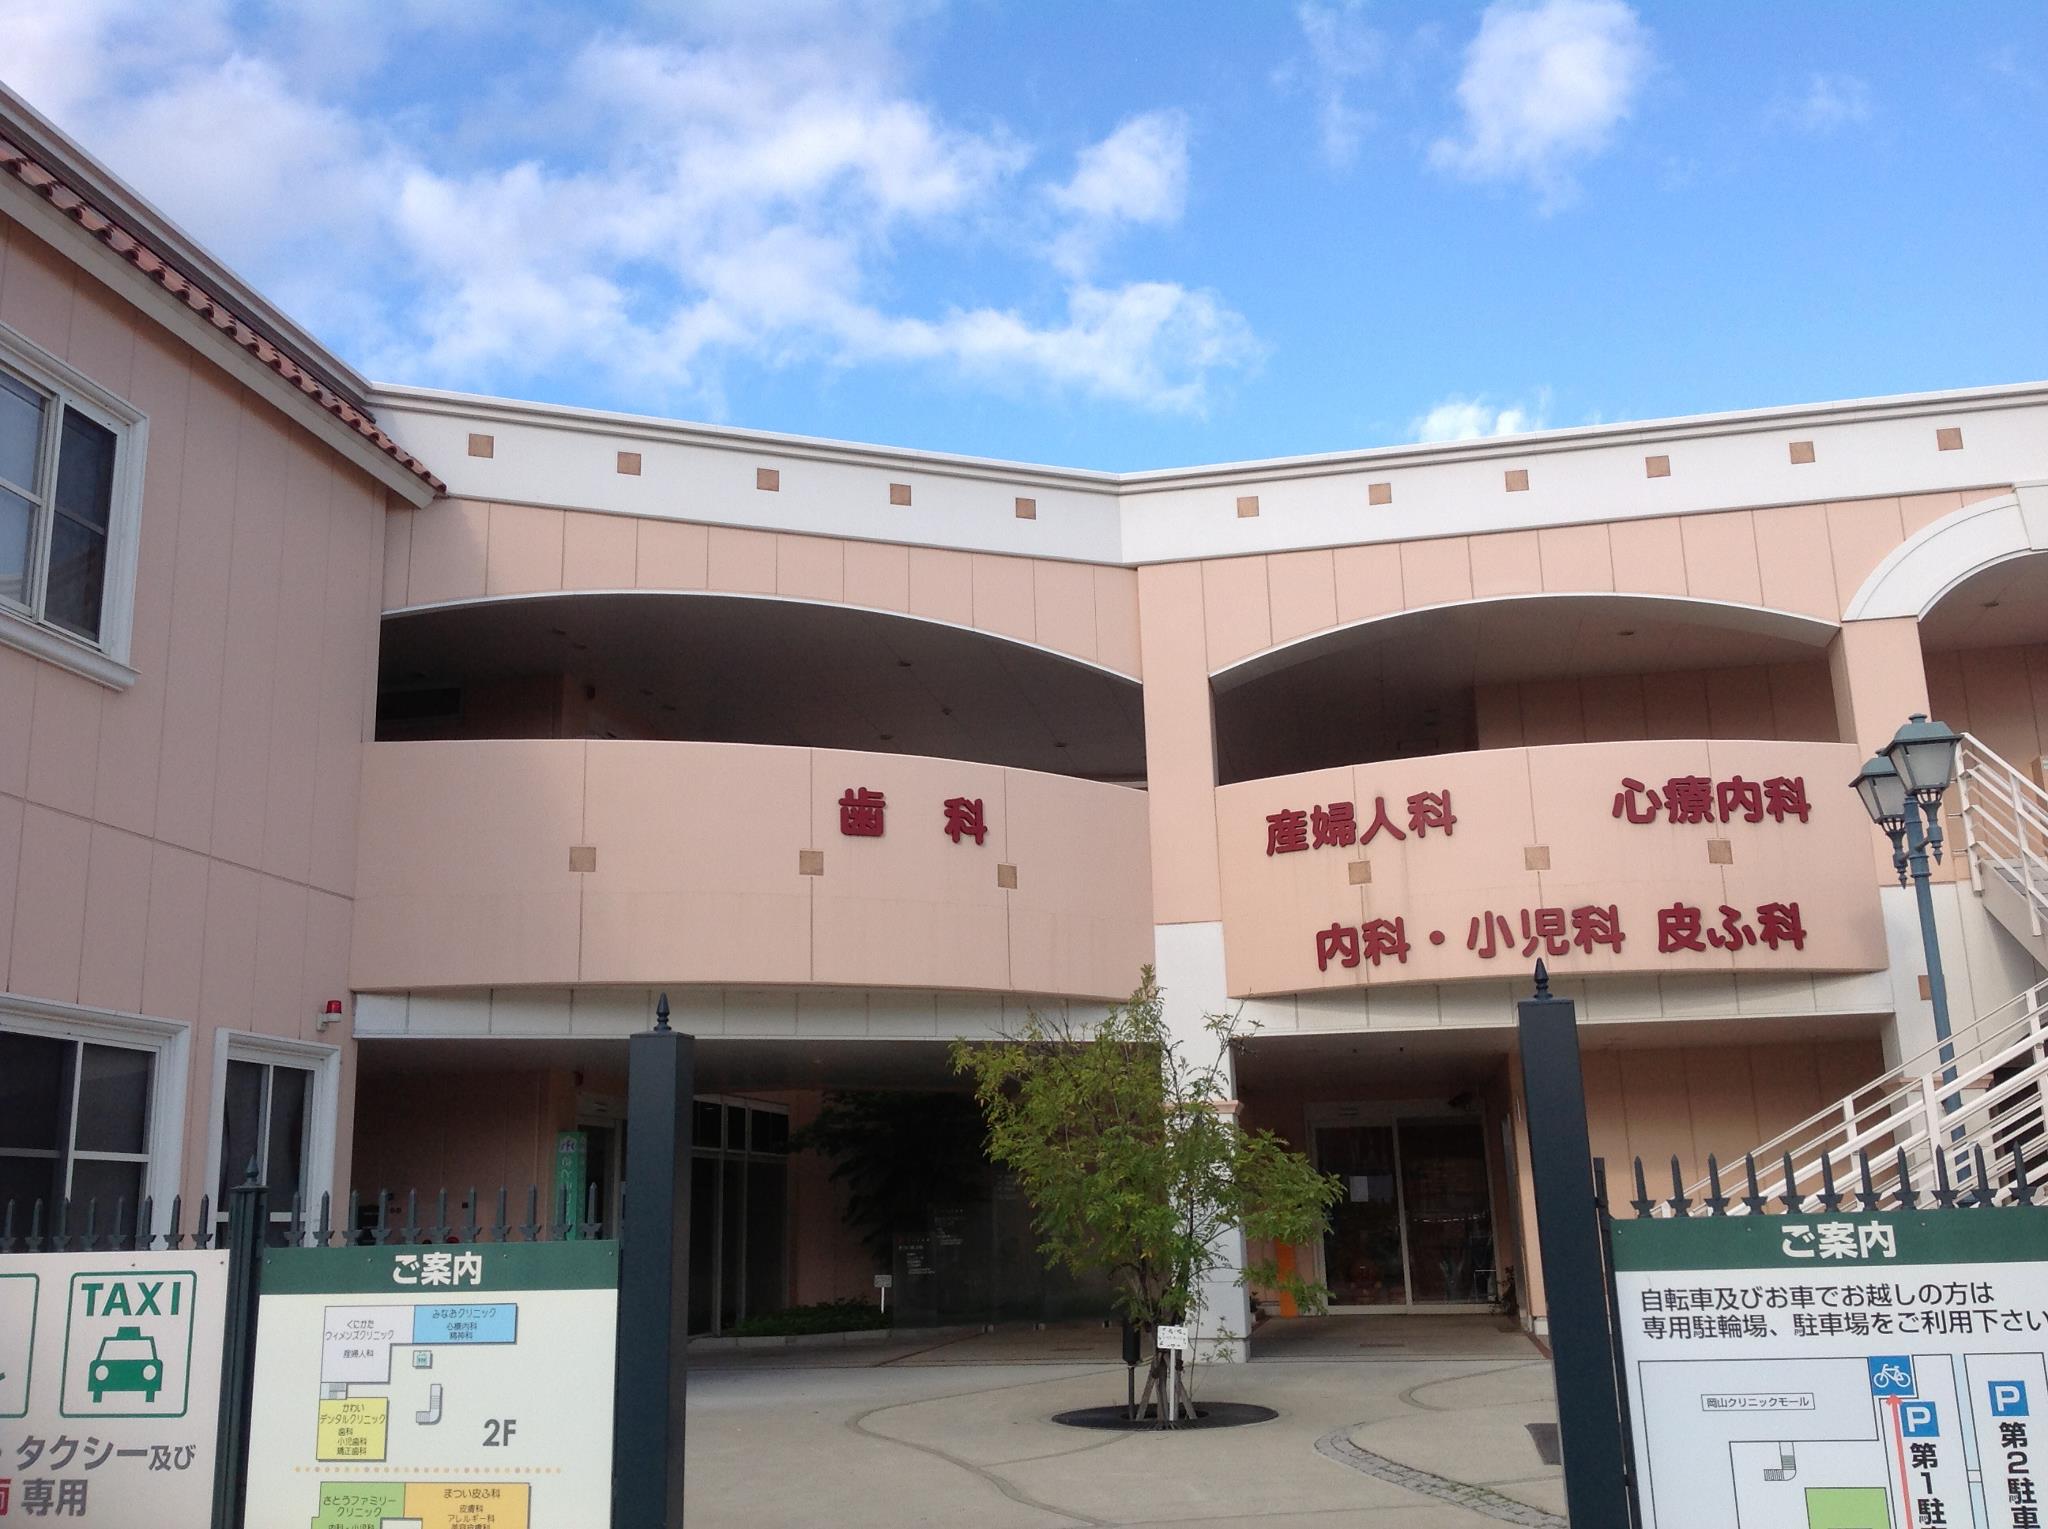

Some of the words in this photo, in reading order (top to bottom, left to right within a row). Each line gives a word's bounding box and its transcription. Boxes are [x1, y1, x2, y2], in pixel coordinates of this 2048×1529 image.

[1612, 775, 1811, 824] 心療内科
[1266, 789, 1457, 856] 産婦人科
[1315, 904, 1626, 972] 内科・小児科
[1658, 902, 1807, 953] 皮ふ科
[1781, 1220, 1897, 1259] ご案内
[392, 1251, 482, 1286] ご案内
[81, 1281, 181, 1316] TAXI
[1641, 1281, 1995, 1312] 自転車及びお車でお越しの方は
[325, 1329, 395, 1341] ウィメンズクリニック
[343, 1348, 375, 1359] 産婦人科
[341, 1403, 366, 1413] かわい
[1706, 1395, 1810, 1409] 岡山クリニックモール
[1995, 1385, 2021, 1412] P
[319, 1413, 387, 1425] デンタルクリニック
[1906, 1406, 1932, 1433] P
[337, 1437, 368, 1446] 小児歯科
[338, 1427, 354, 1437] 歯科
[482, 1418, 517, 1447] 2F
[16, 1434, 197, 1472] タクシー及び
[336, 1446, 368, 1456] 矯正歯科
[443, 1487, 501, 1500] まつい皮ふ科
[1909, 1442, 1948, 1529] 第1駐
[21, 1477, 89, 1517] 専用
[323, 1494, 398, 1506] さとうファミリー
[336, 1506, 382, 1518] クリニック
[447, 1513, 495, 1523] アレルギー科
[459, 1503, 484, 1513] 皮膚科
